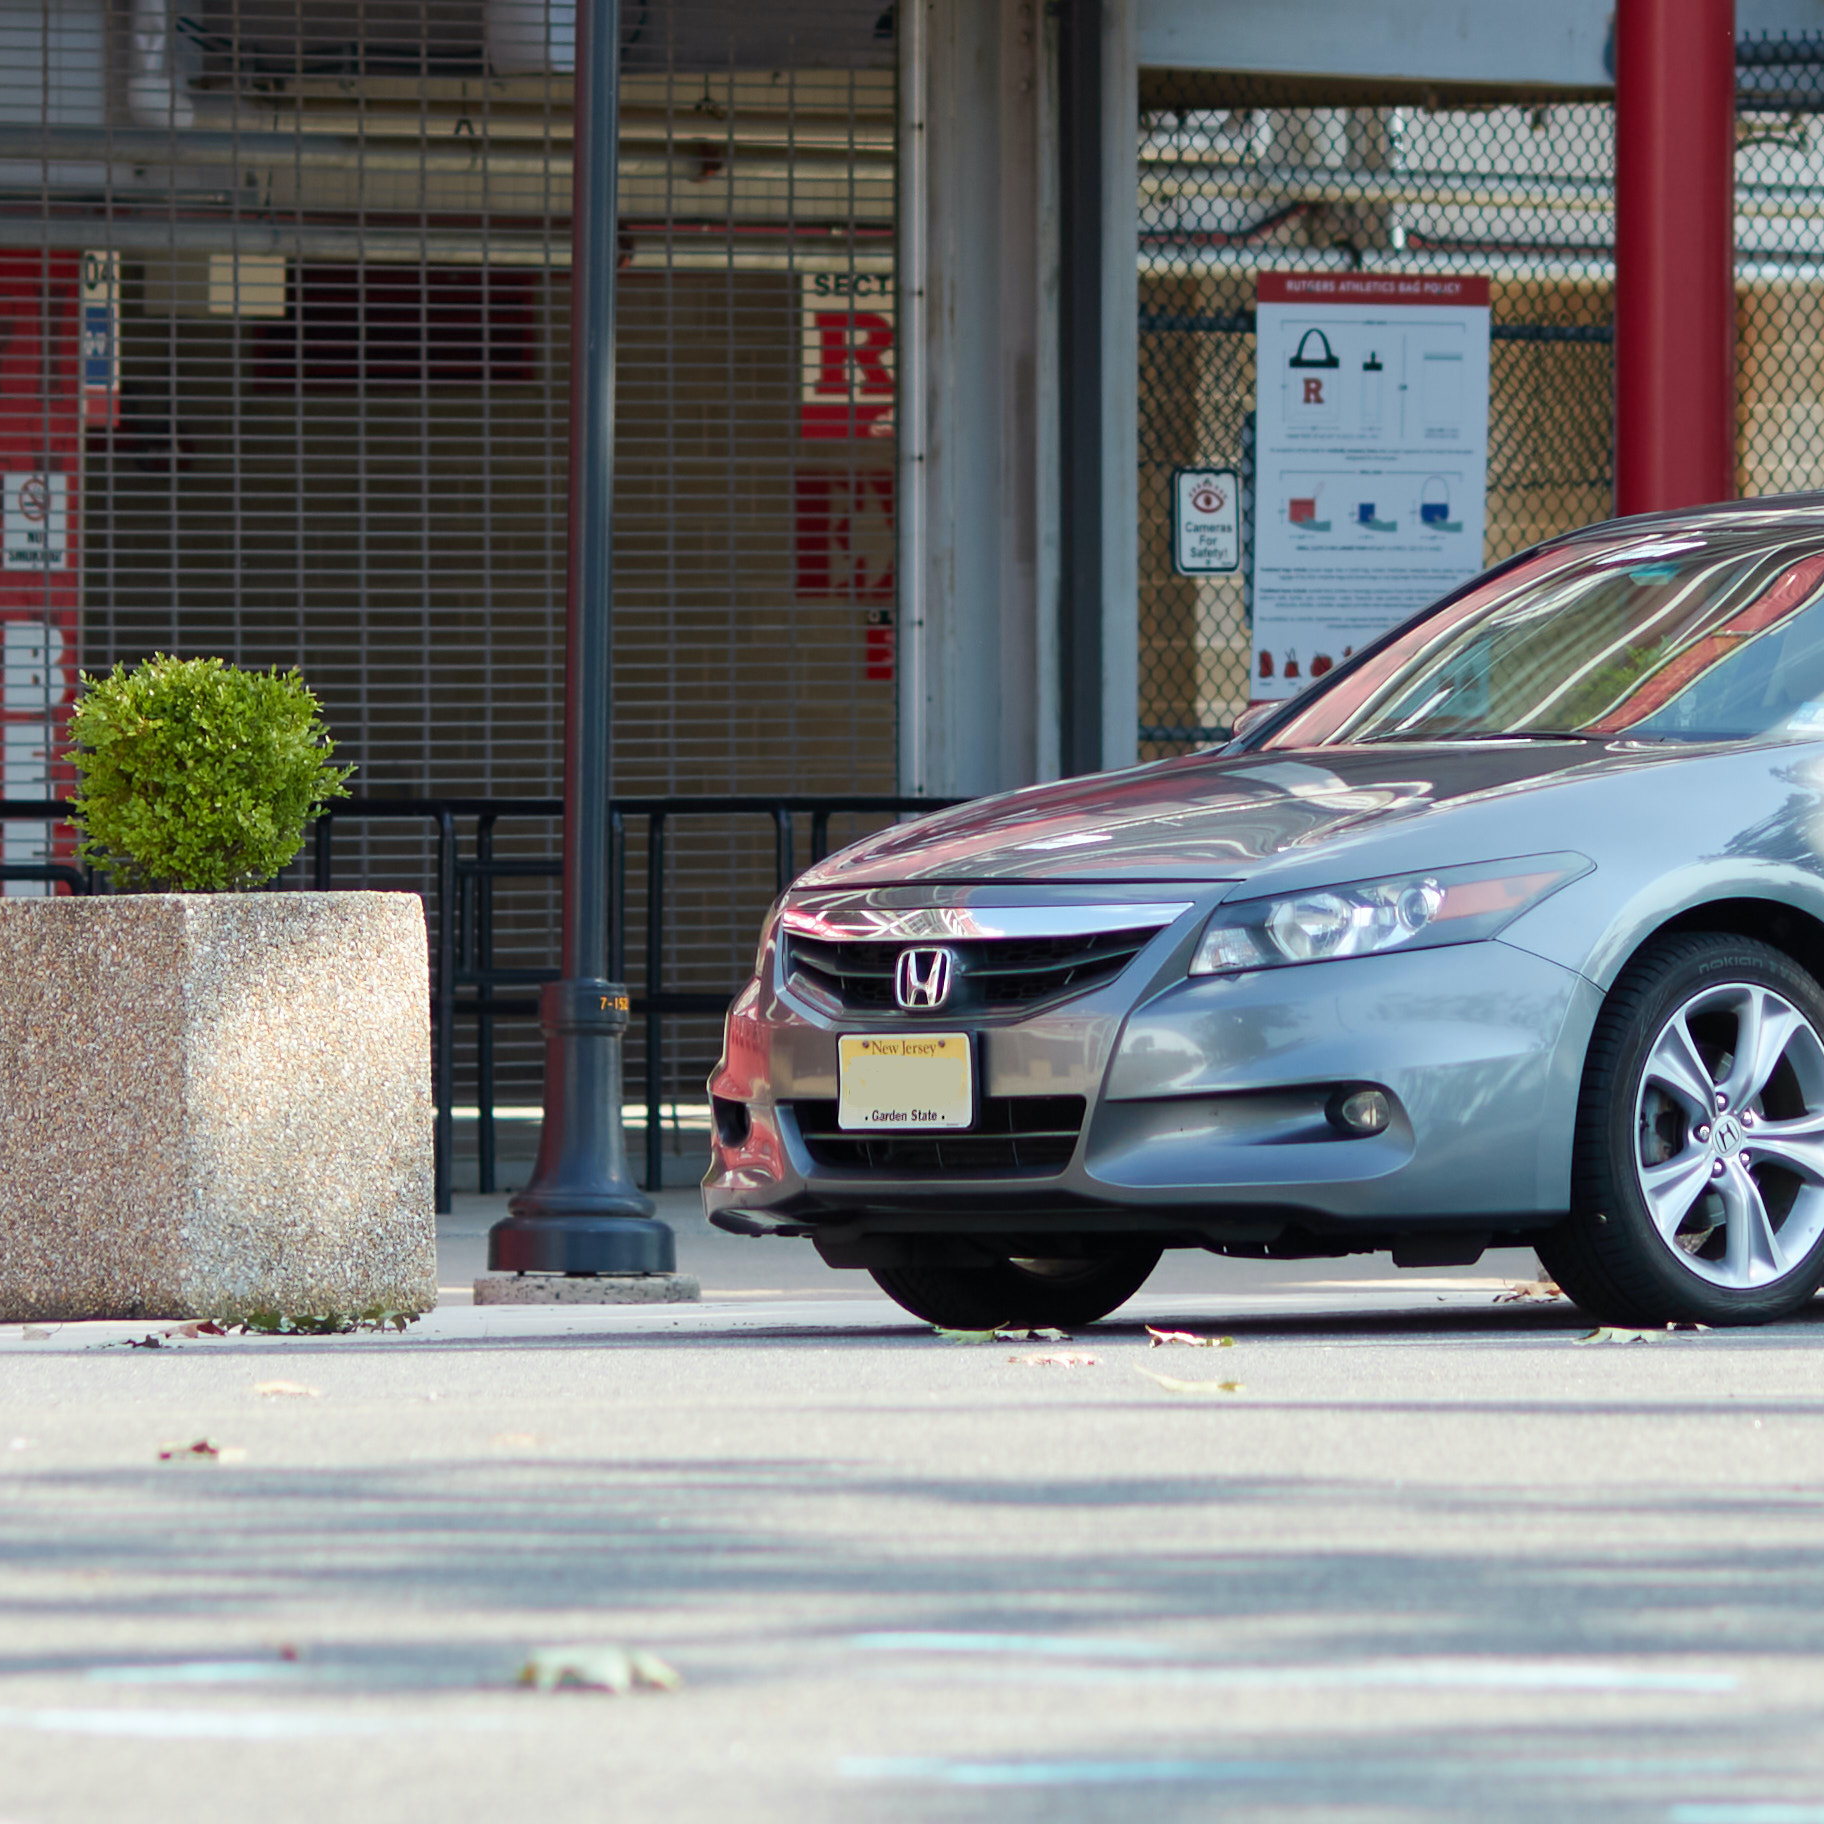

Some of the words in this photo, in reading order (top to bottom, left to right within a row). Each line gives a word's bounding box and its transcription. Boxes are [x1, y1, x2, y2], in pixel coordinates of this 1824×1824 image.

[1285, 279, 1335, 293] RUTGERS
[1338, 280, 1395, 293] ATHLETICS
[1399, 280, 1421, 293] BAG
[1424, 281, 1462, 295] POLICY
[1184, 521, 1233, 533] Cameras
[1199, 535, 1218, 546] For
[1189, 546, 1228, 560] Safety!
[871, 1041, 900, 1056] New
[900, 1040, 938, 1057] Jersey
[871, 1109, 908, 1122] Garden
[911, 1108, 938, 1122] State
